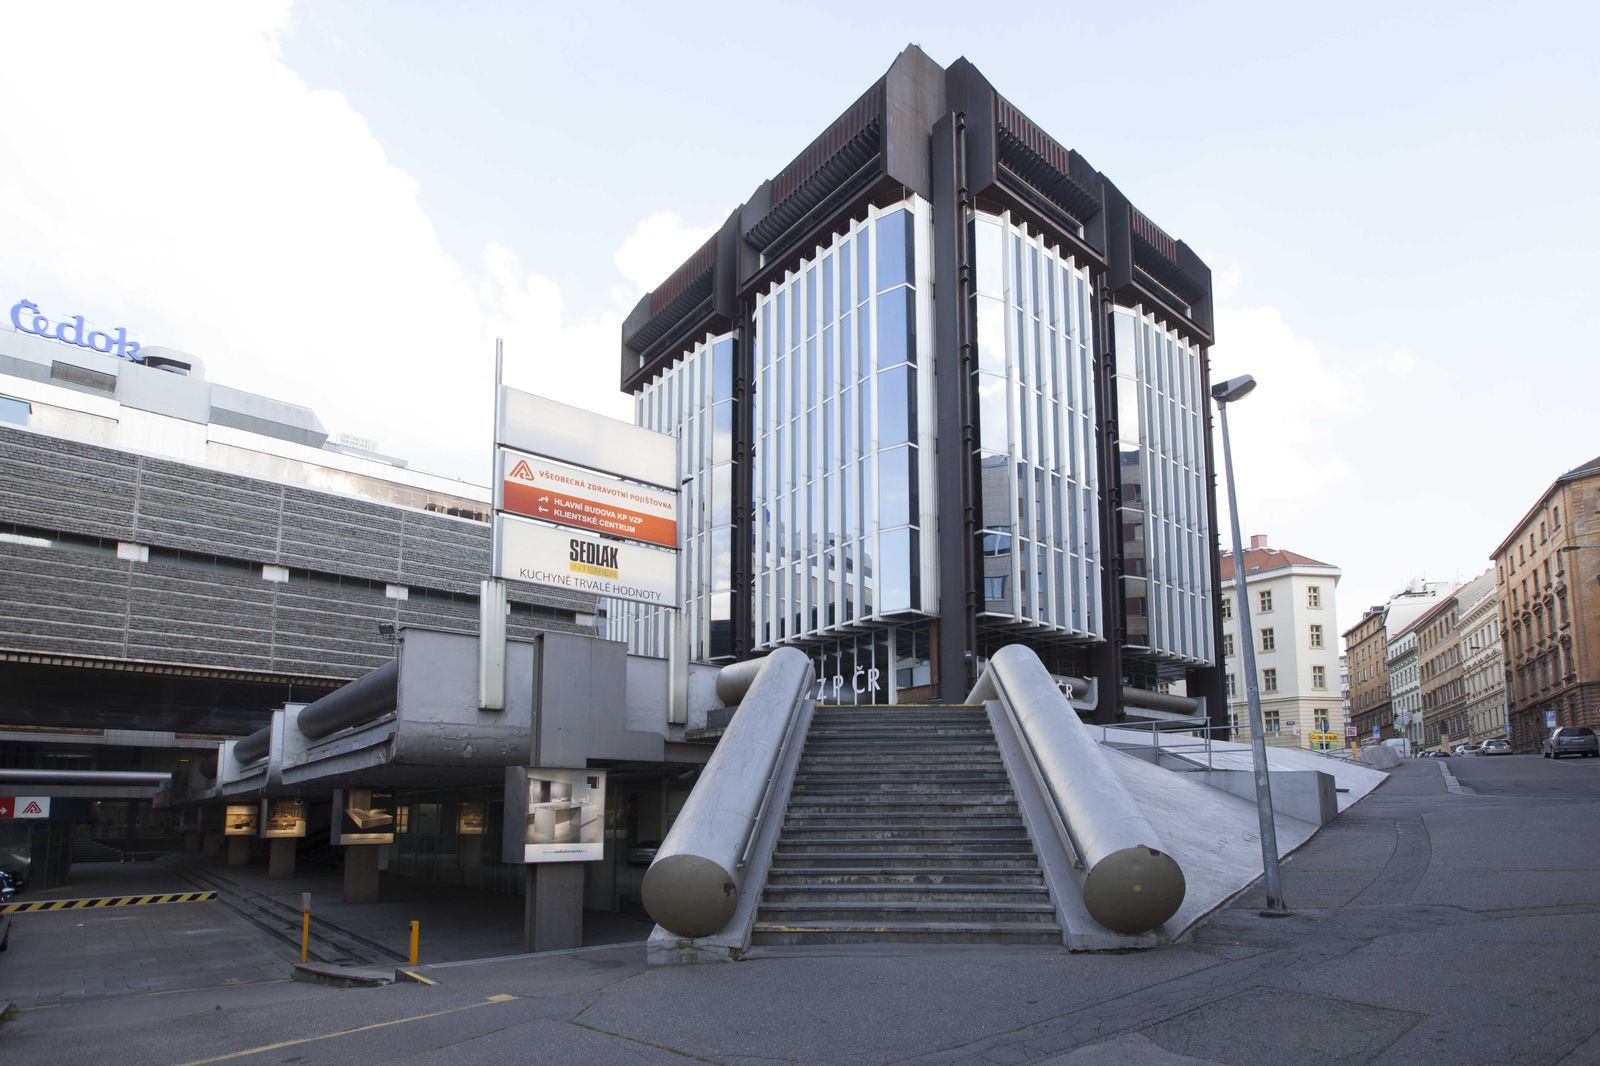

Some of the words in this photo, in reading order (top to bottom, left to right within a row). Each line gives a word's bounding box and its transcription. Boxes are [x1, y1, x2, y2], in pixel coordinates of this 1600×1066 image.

[10, 299, 145, 361] Čedok
[539, 470, 585, 488] VŠEOBECNÁ
[587, 483, 629, 499] ZDRAVOTNÍ
[554, 498, 583, 510] HLAVNÍ
[585, 506, 616, 518] BUDOVA
[617, 512, 628, 521] KP
[628, 515, 644, 524] VZP
[554, 509, 598, 525] KLIENTSKÉ
[599, 519, 636, 533] CENTRUM
[569, 539, 619, 569] SEDLÁK
[574, 577, 610, 593] TRVALÉ
[613, 584, 662, 600] HODNOTY
[852, 665, 881, 694] ČR
